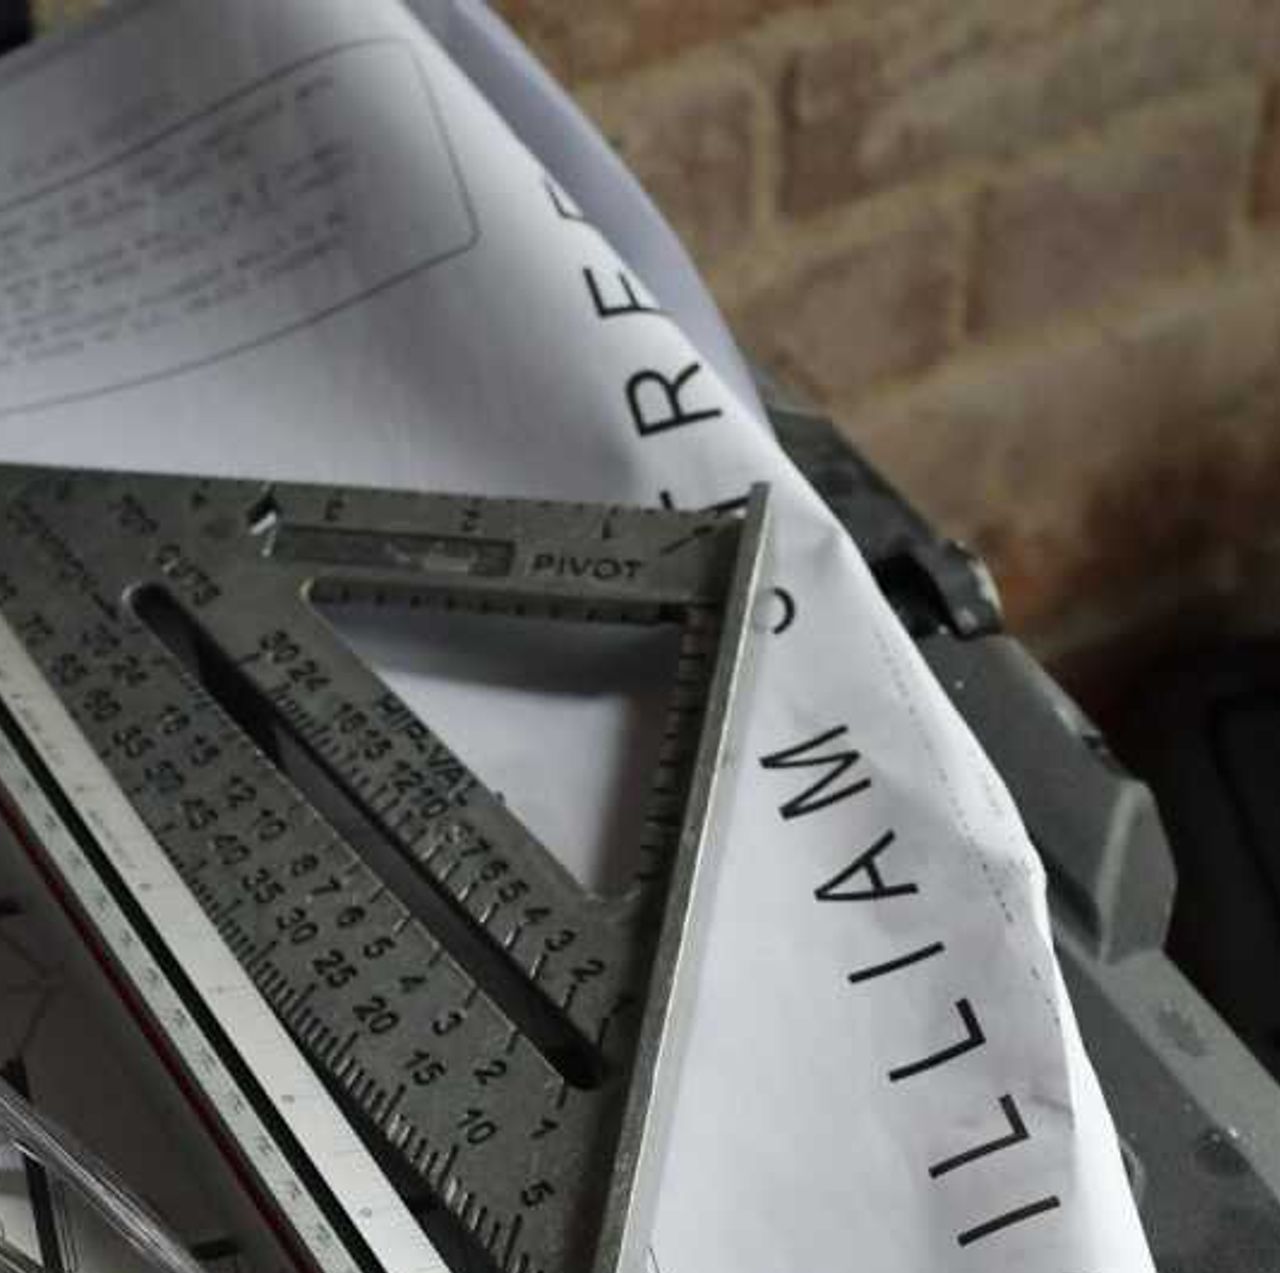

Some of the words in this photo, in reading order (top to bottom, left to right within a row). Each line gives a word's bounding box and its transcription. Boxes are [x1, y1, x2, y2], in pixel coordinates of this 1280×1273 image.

[531, 551, 644, 580] PIVOT
[311, 875, 342, 896] 7
[337, 906, 366, 928] 6
[363, 936, 396, 960] 5
[432, 1012, 463, 1037] 3
[473, 1059, 508, 1086] 2
[532, 1118, 559, 1139] 1
[544, 929, 577, 952] 3
[572, 959, 606, 983] 2
[241, 868, 285, 905] 35
[276, 907, 319, 945] 30
[312, 949, 358, 989] 25
[352, 996, 399, 1035] 20
[406, 1051, 446, 1086] 15
[458, 1108, 498, 1145] 10
[521, 1180, 555, 1208] 5
